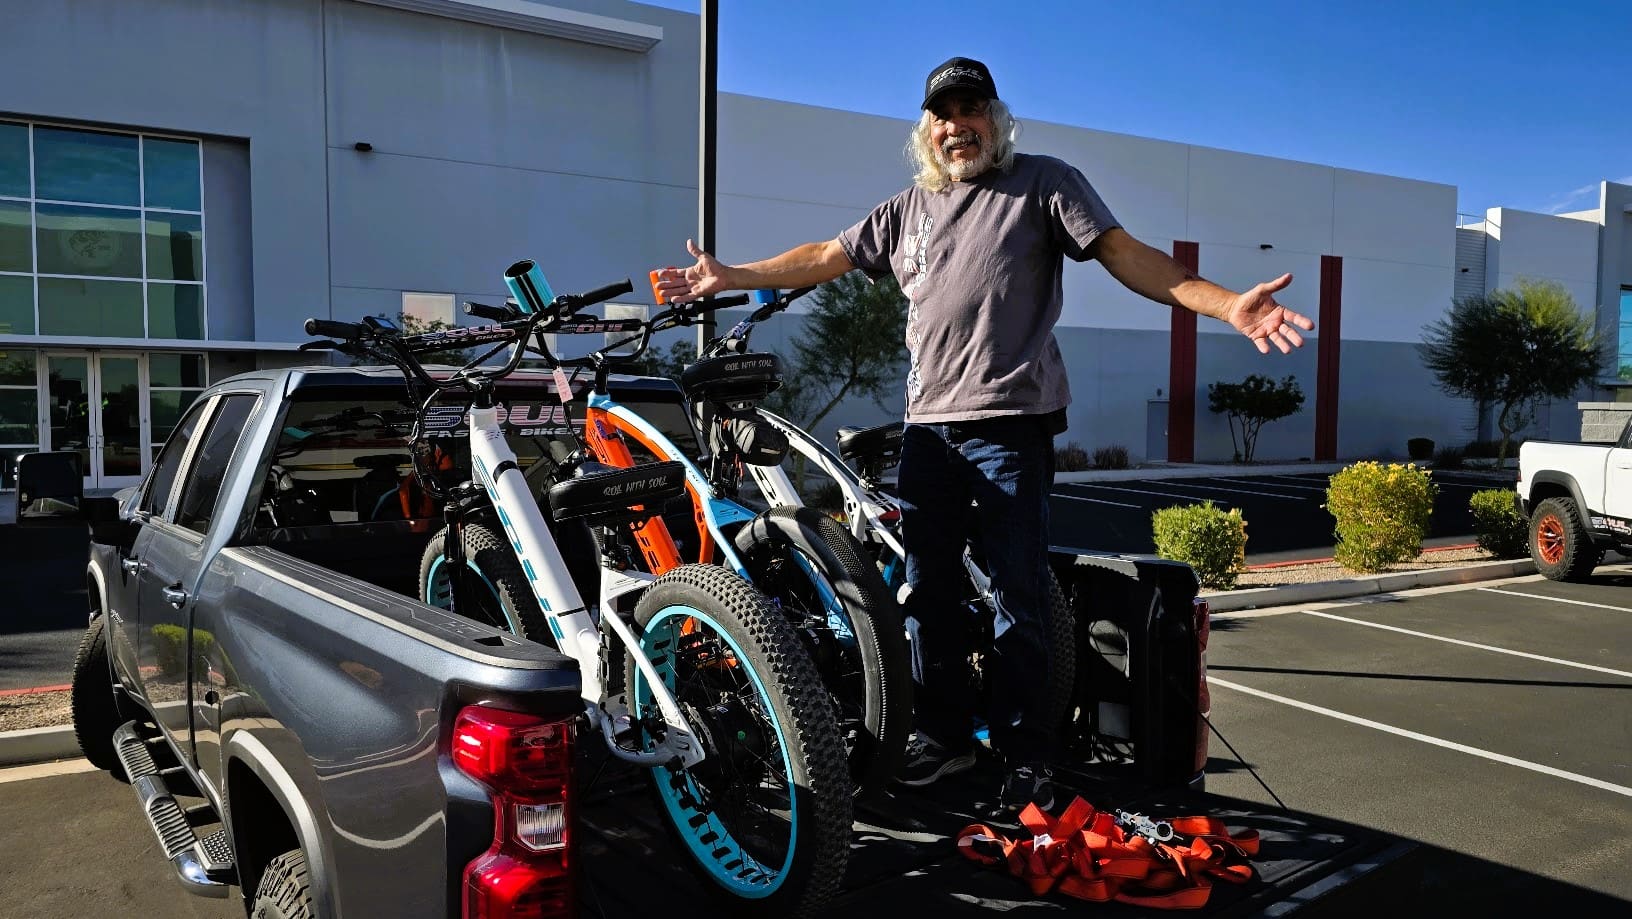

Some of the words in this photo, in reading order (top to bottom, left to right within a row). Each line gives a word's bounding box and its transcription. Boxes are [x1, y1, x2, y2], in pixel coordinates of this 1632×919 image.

[421, 430, 470, 438] FAS
[519, 427, 582, 436] BIKES
[648, 475, 668, 489] SOUL
